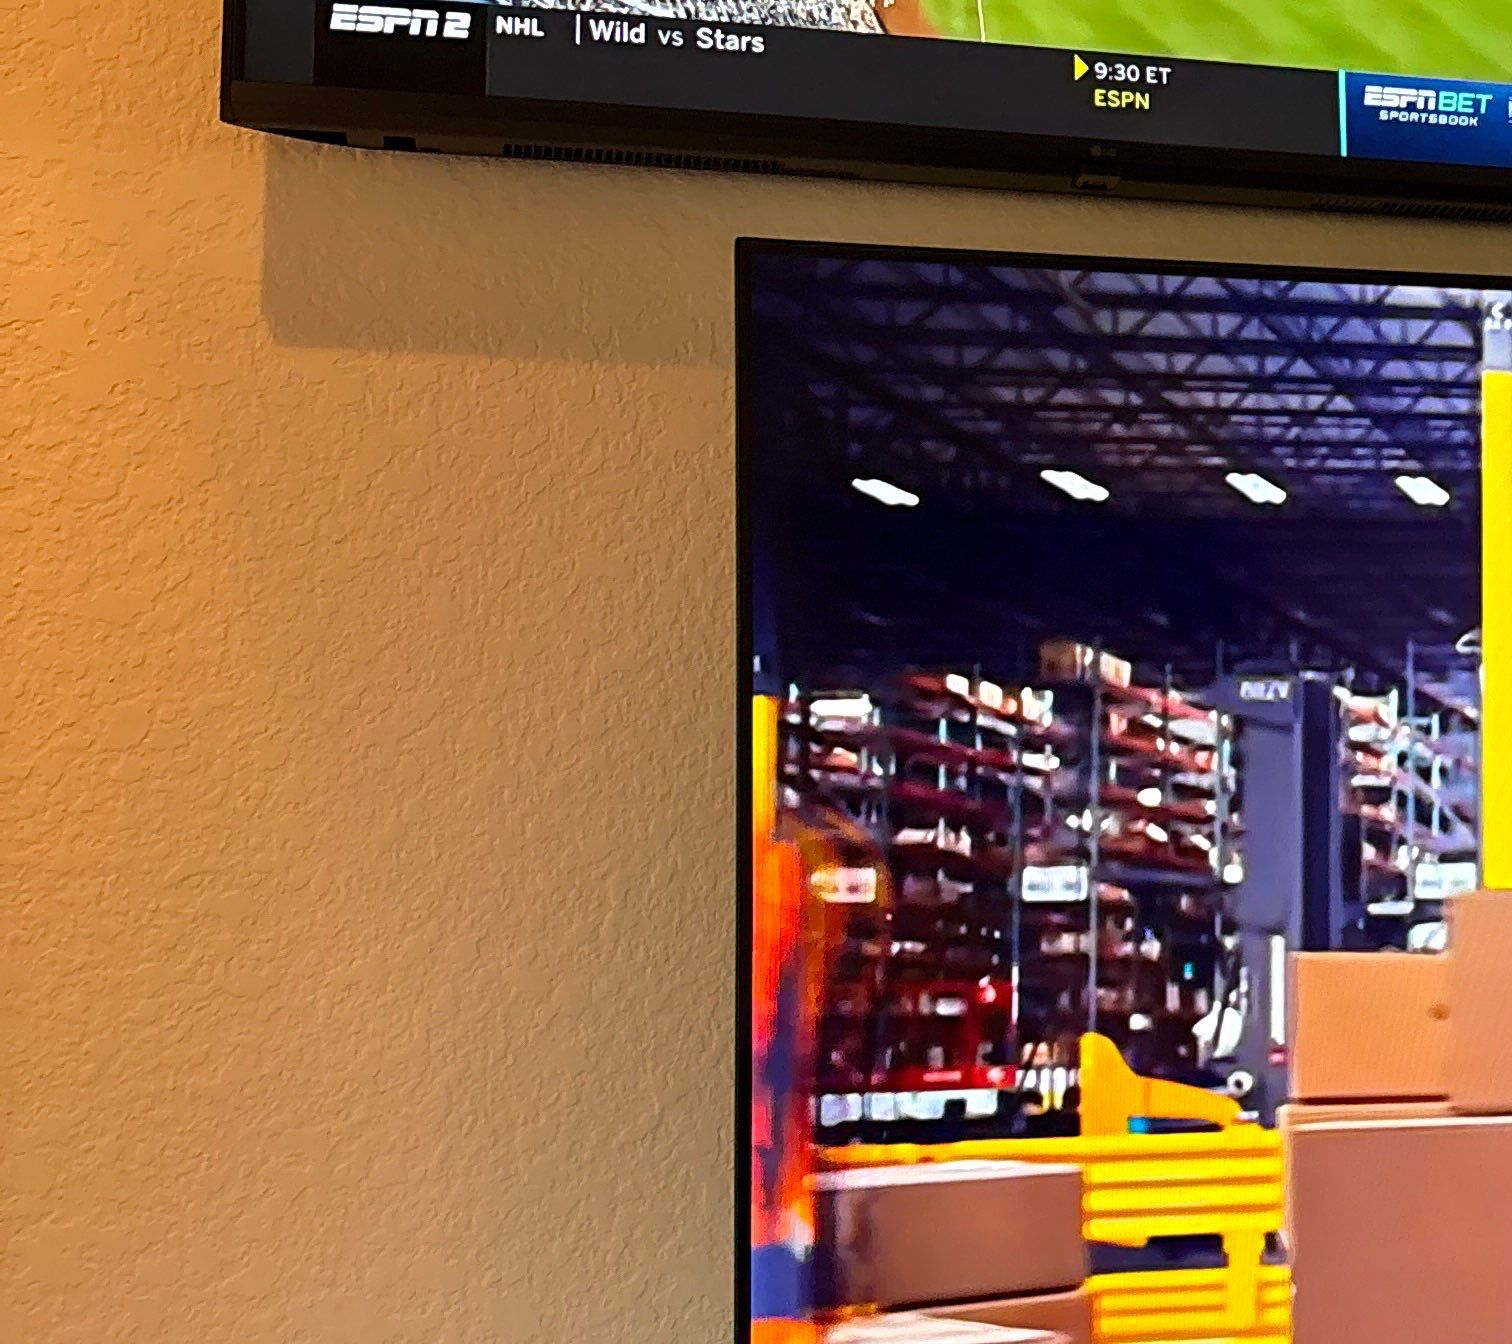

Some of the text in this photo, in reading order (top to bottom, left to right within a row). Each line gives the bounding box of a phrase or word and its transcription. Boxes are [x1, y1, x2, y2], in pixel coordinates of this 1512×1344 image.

[495, 15, 546, 39] NHL
[589, 18, 766, 54] Wild vs Stars
[1094, 61, 1172, 86] 9:30 ET
[1093, 88, 1151, 110] ESPN
[1379, 109, 1479, 128] SPORTSBOOK
